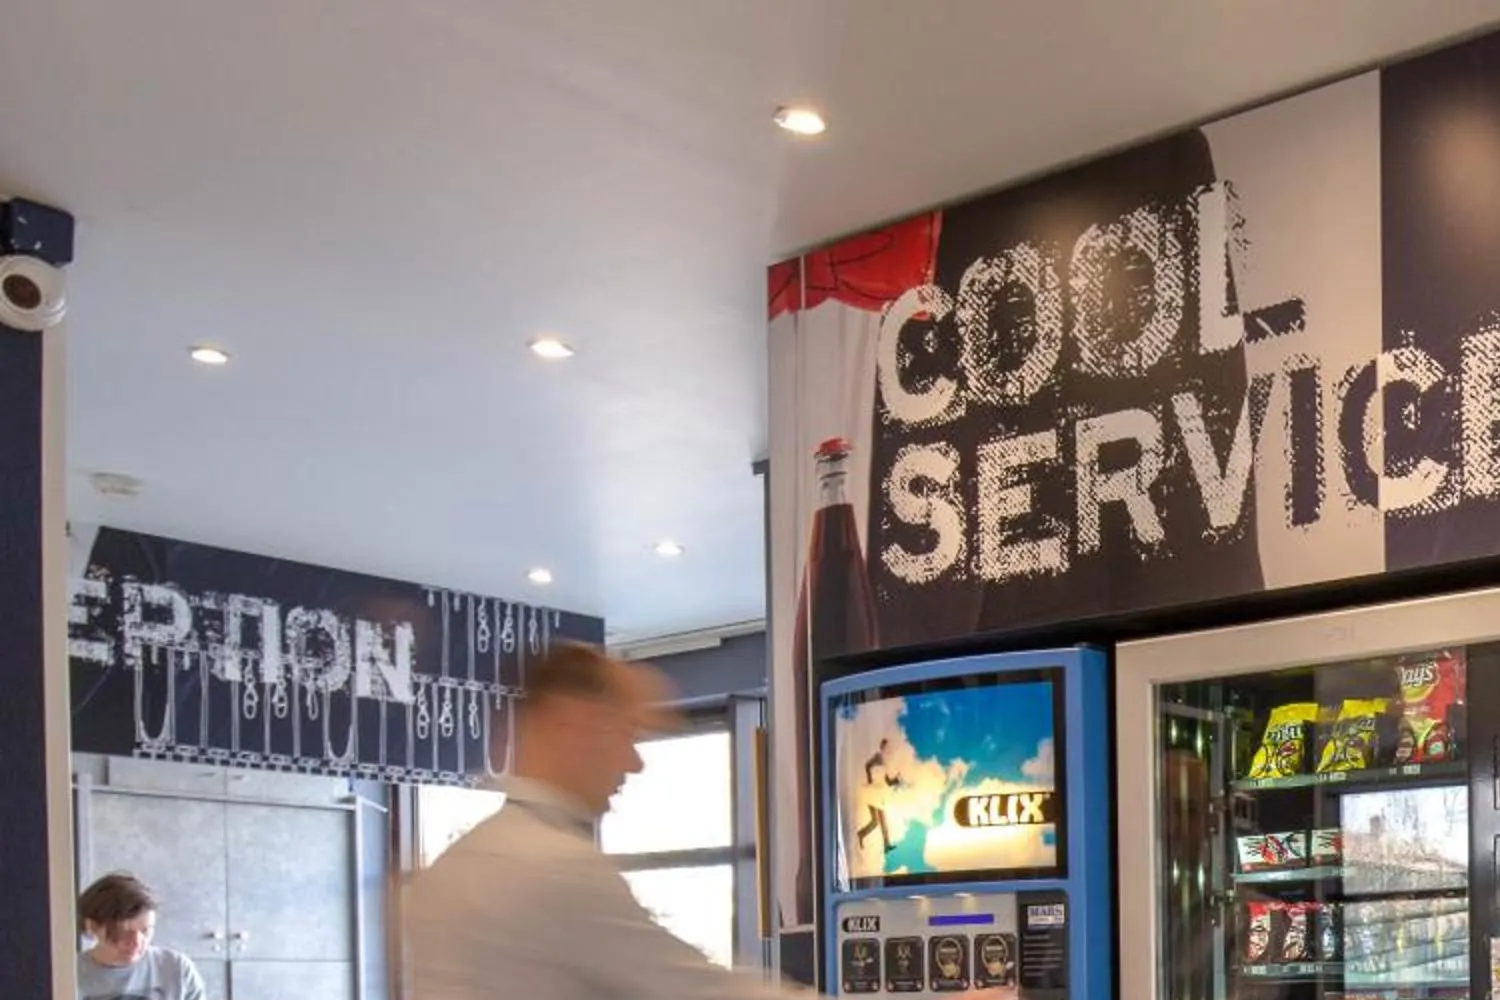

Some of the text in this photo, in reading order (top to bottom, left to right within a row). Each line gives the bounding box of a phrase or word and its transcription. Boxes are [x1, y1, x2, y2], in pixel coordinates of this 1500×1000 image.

[877, 179, 1306, 427] COOL
[967, 792, 1045, 827] KLIX
[847, 916, 877, 932] KLIX
